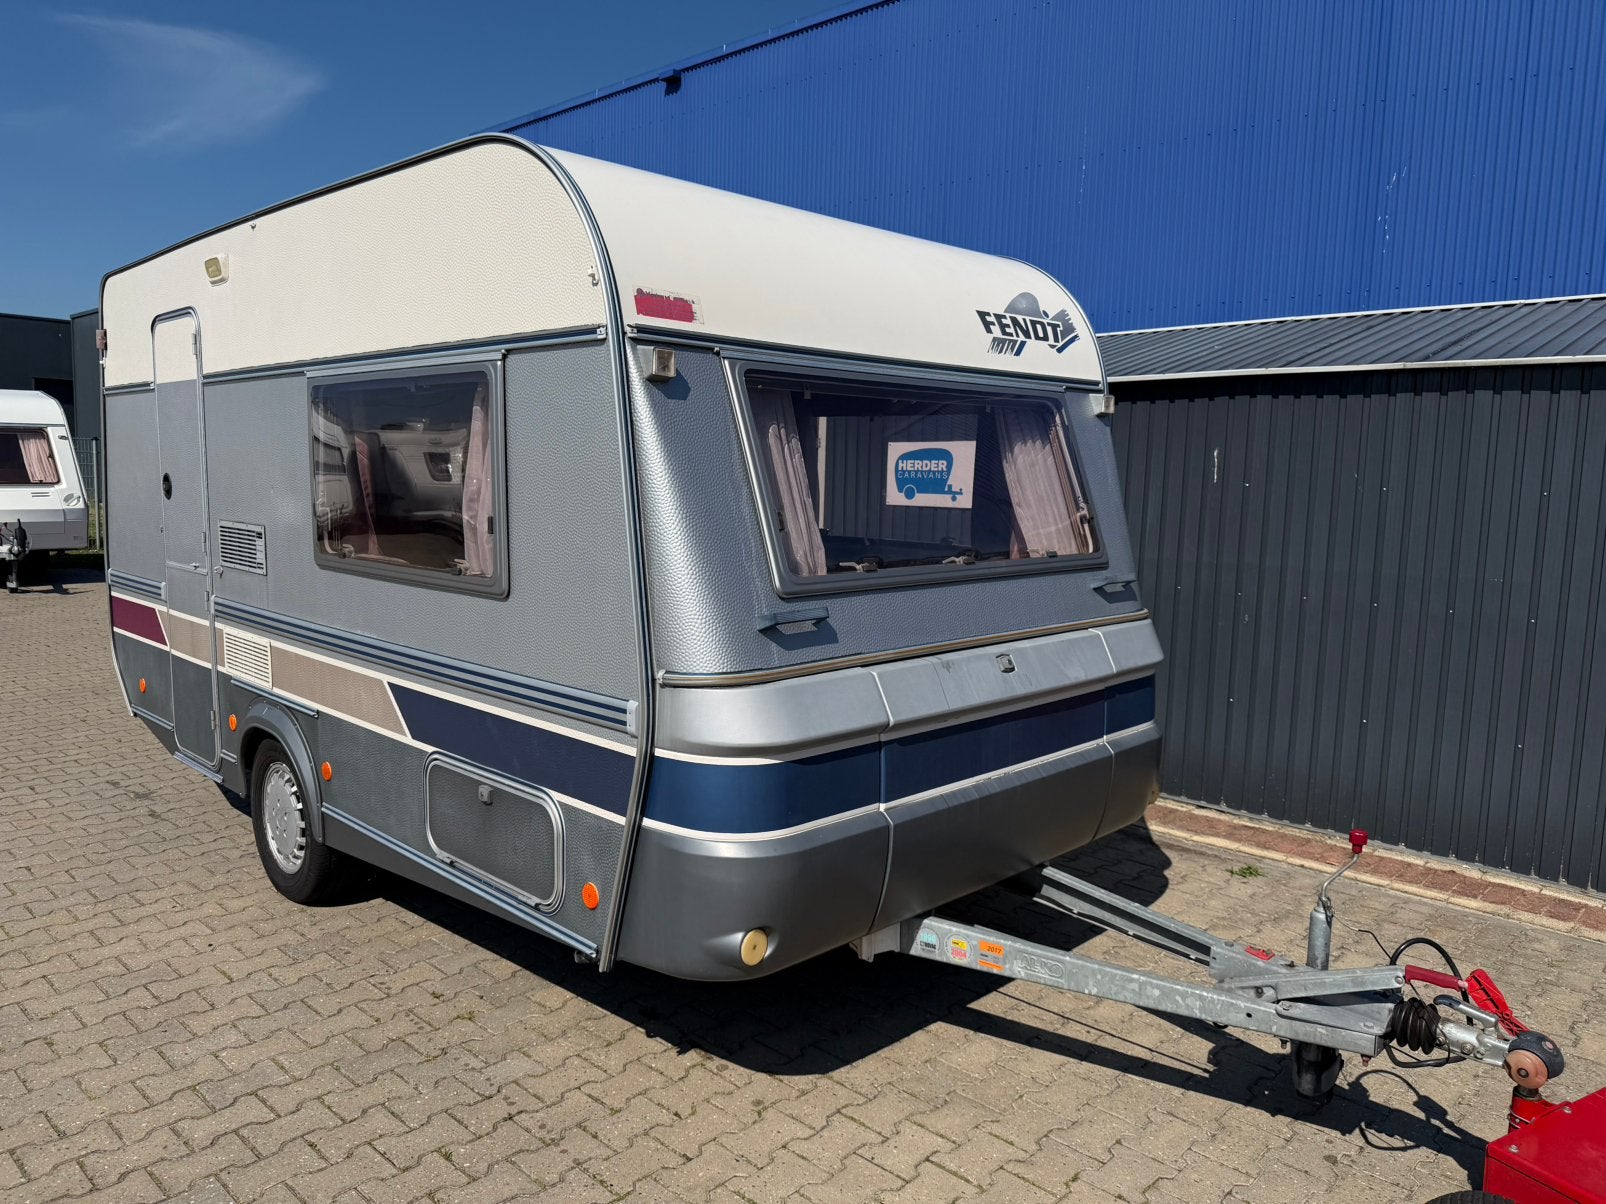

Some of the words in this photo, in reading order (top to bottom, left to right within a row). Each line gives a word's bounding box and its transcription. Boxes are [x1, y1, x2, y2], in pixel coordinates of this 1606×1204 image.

[976, 309, 1061, 344] FENDT
[898, 460, 948, 471] HERDER
[897, 471, 948, 479] CARAVANS
[987, 945, 1002, 955] 2017
